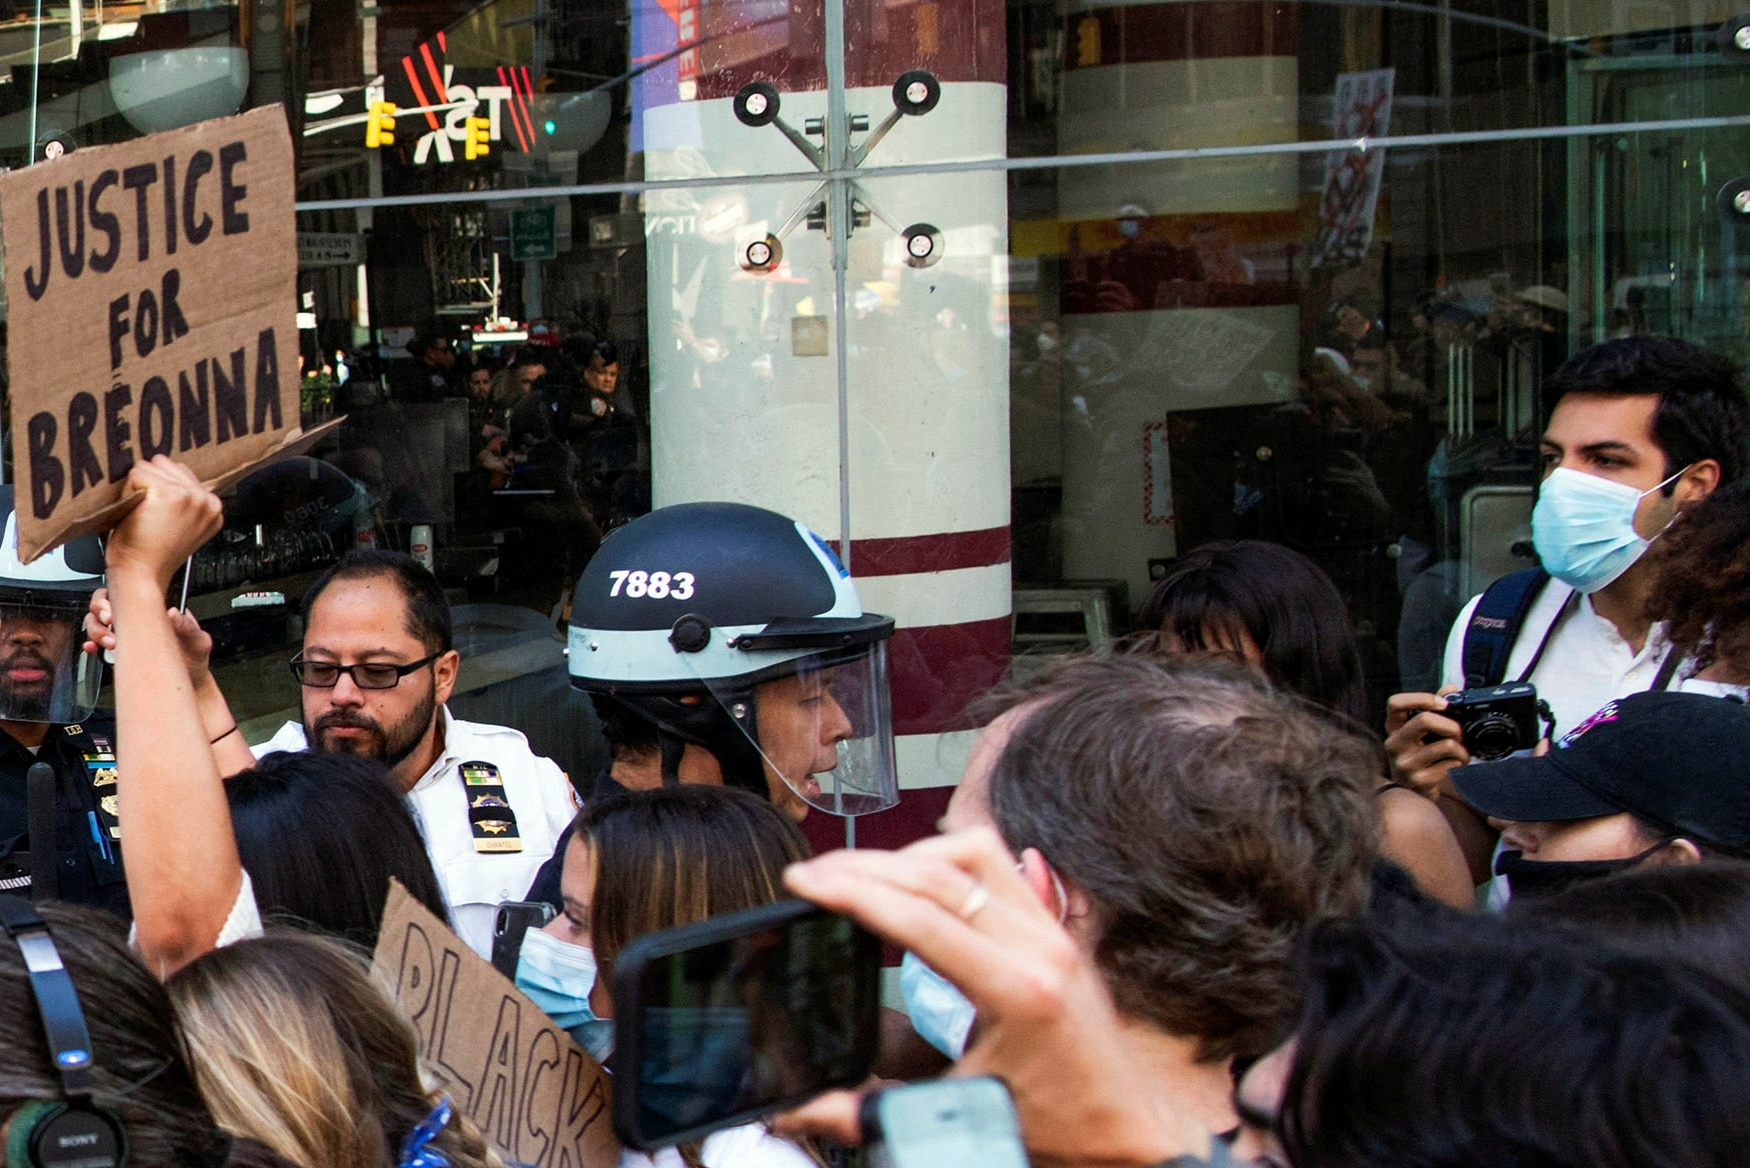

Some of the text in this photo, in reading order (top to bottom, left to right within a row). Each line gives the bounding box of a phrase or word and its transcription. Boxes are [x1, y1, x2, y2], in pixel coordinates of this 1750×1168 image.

[23, 141, 250, 302] JUSTICE
[109, 268, 190, 372] FOR
[27, 327, 283, 521] BREONNA
[608, 569, 696, 601] 7883
[58, 1132, 99, 1148] SONY
